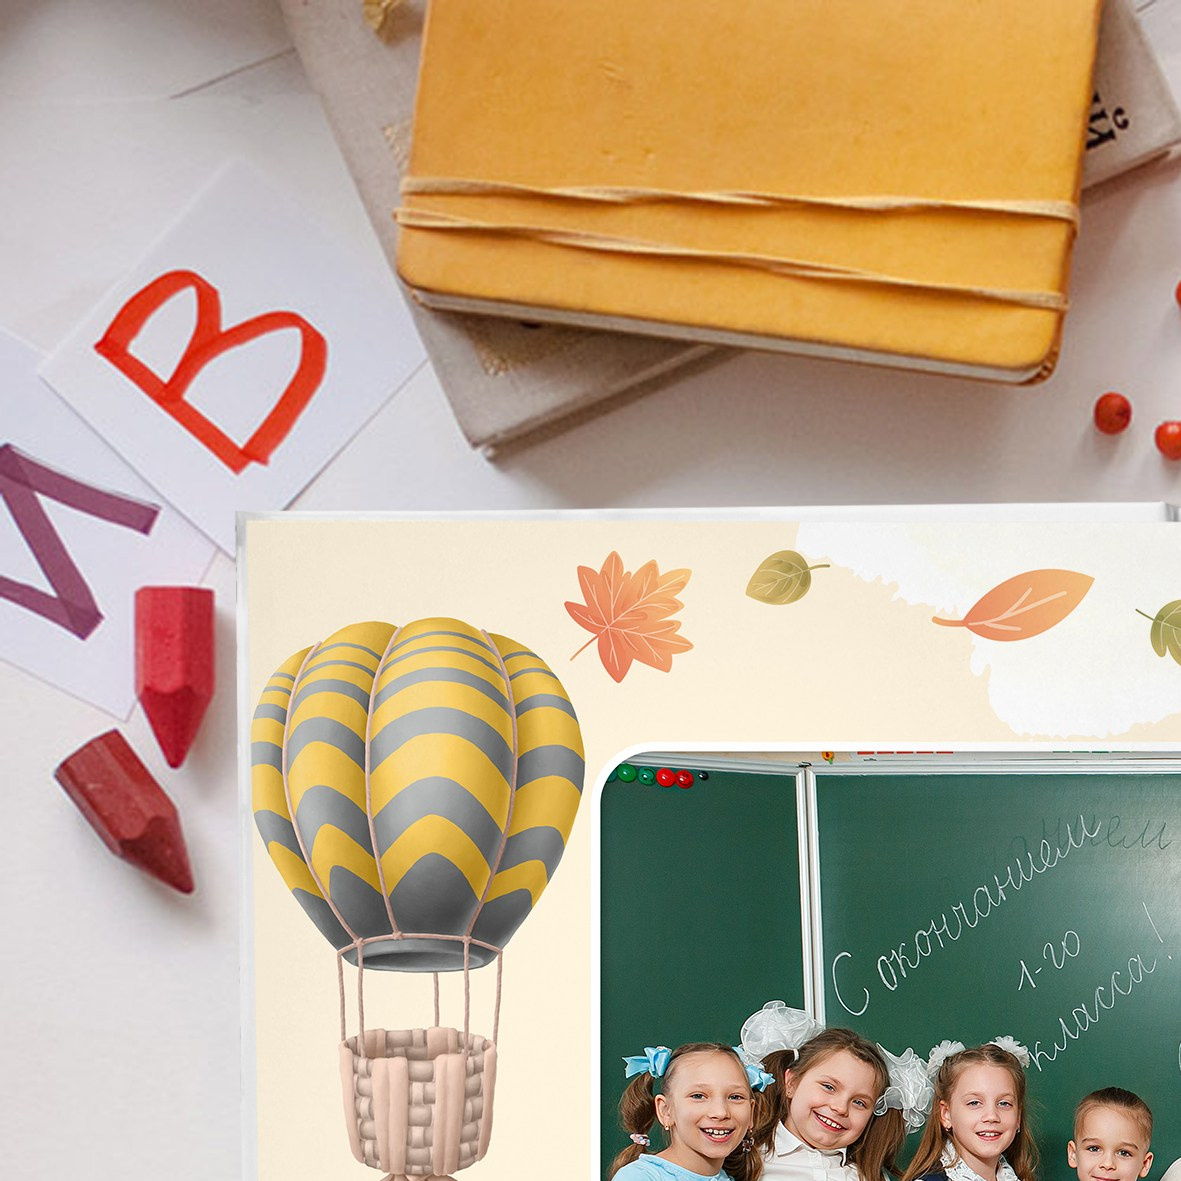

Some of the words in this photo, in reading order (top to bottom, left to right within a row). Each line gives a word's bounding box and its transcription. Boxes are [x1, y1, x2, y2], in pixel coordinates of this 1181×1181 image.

[94, 269, 328, 475] В
[832, 951, 870, 1017] С
[876, 814, 1102, 991] окончанием
[1018, 930, 1081, 991] 1-го
